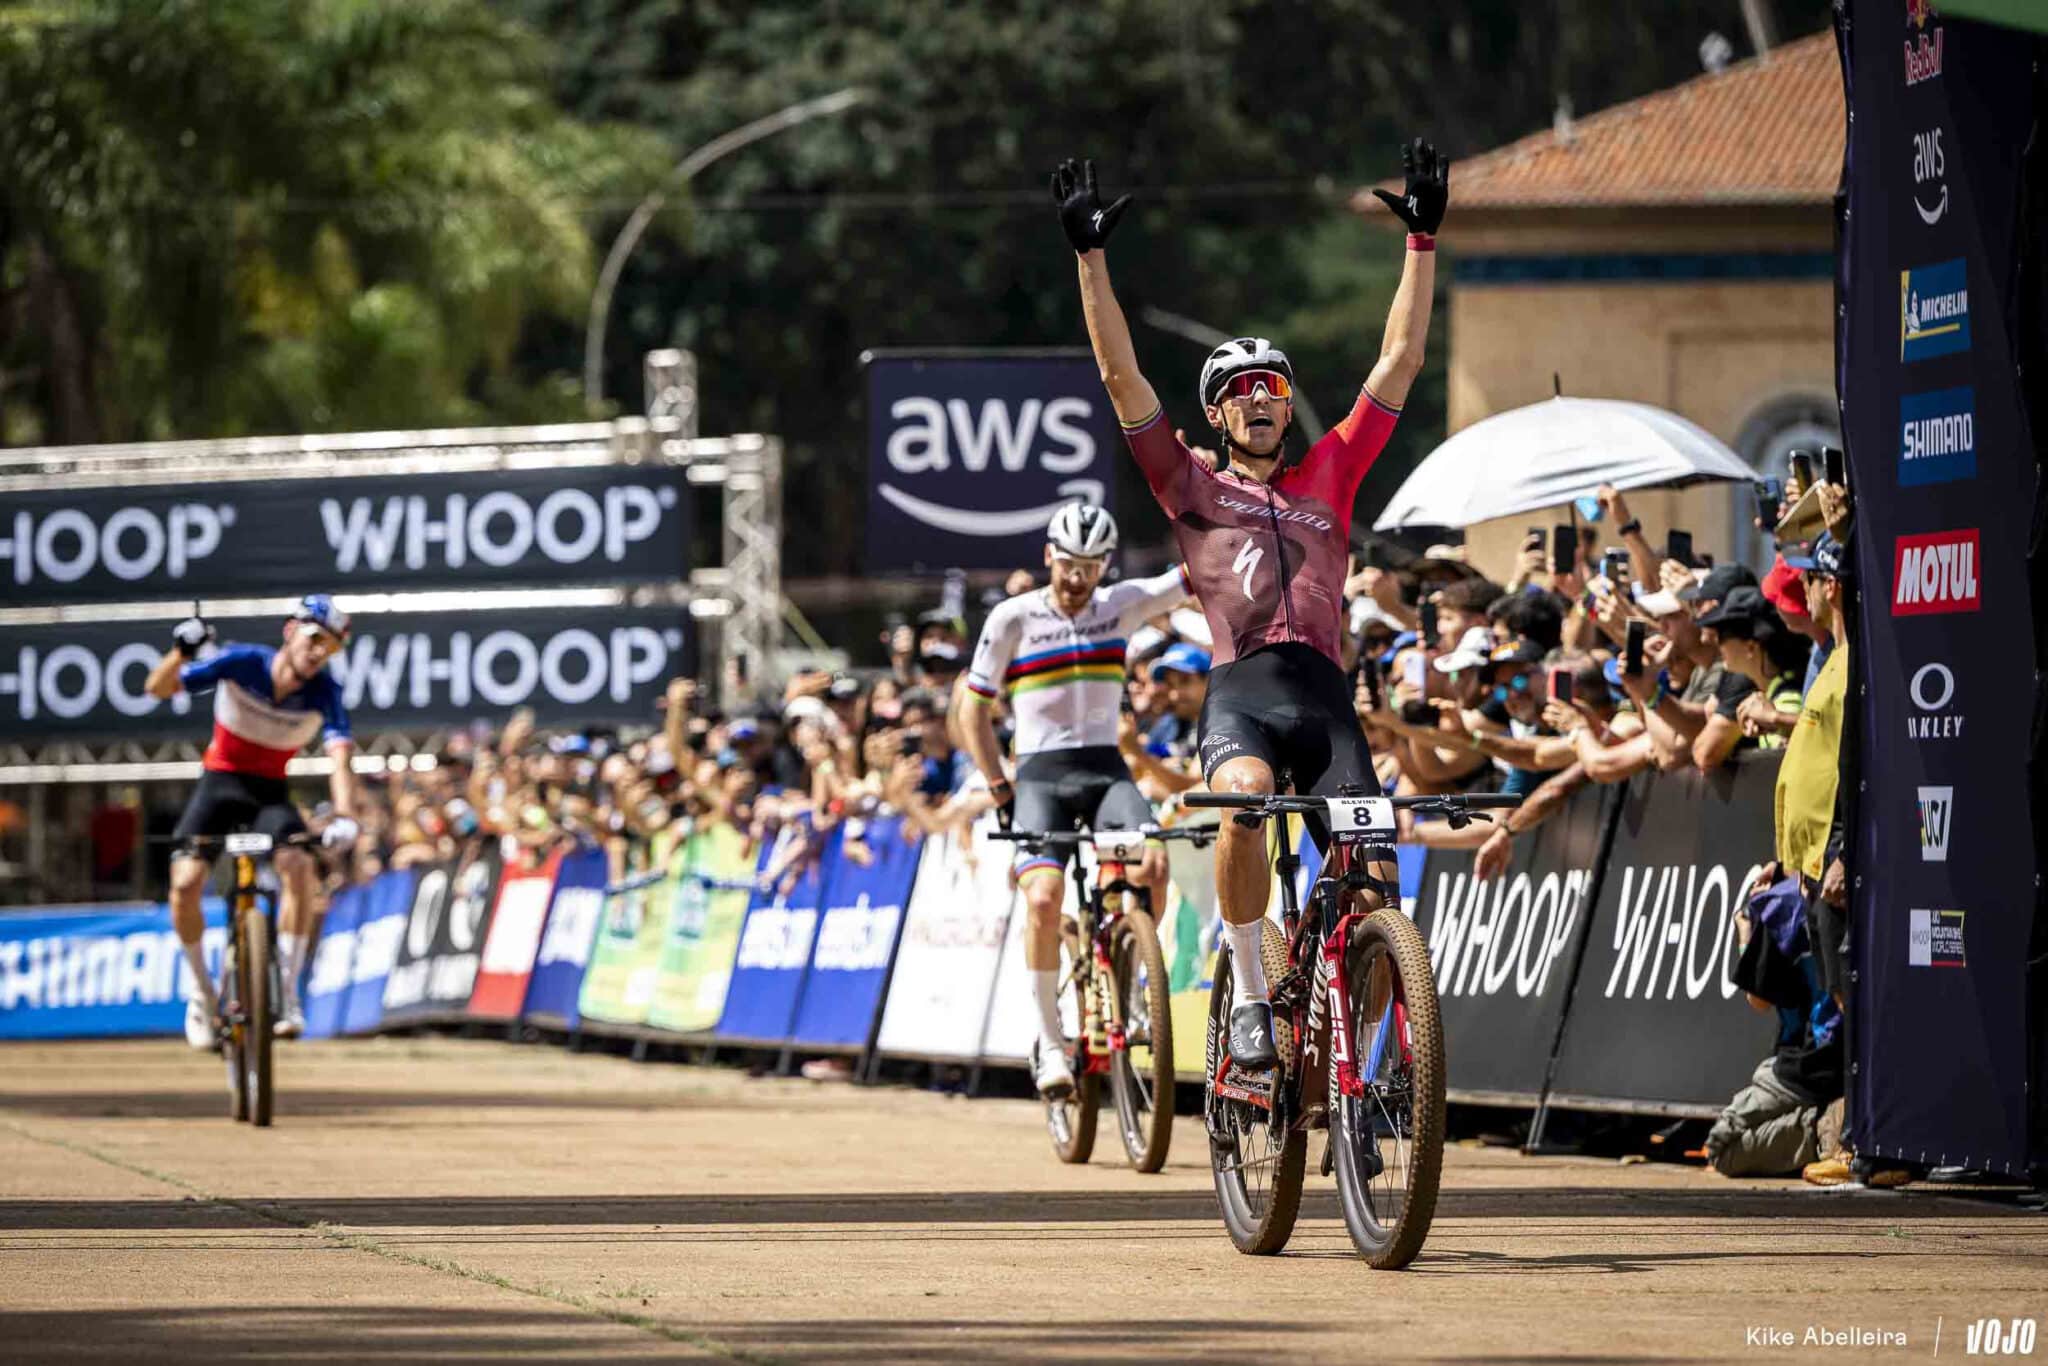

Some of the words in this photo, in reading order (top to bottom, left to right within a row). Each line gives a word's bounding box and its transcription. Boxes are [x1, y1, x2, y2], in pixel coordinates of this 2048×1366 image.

[1914, 127, 1945, 184] aws
[1921, 289, 1968, 322] MICHELIN
[887, 397, 1097, 474] aws
[1904, 413, 1973, 460] SHIMANO
[320, 486, 662, 573] WHOOP
[1897, 542, 1977, 605] MOTUL
[0, 641, 200, 720] HOO
[1353, 806, 1372, 827] 8
[1428, 869, 1588, 998] WHOOP
